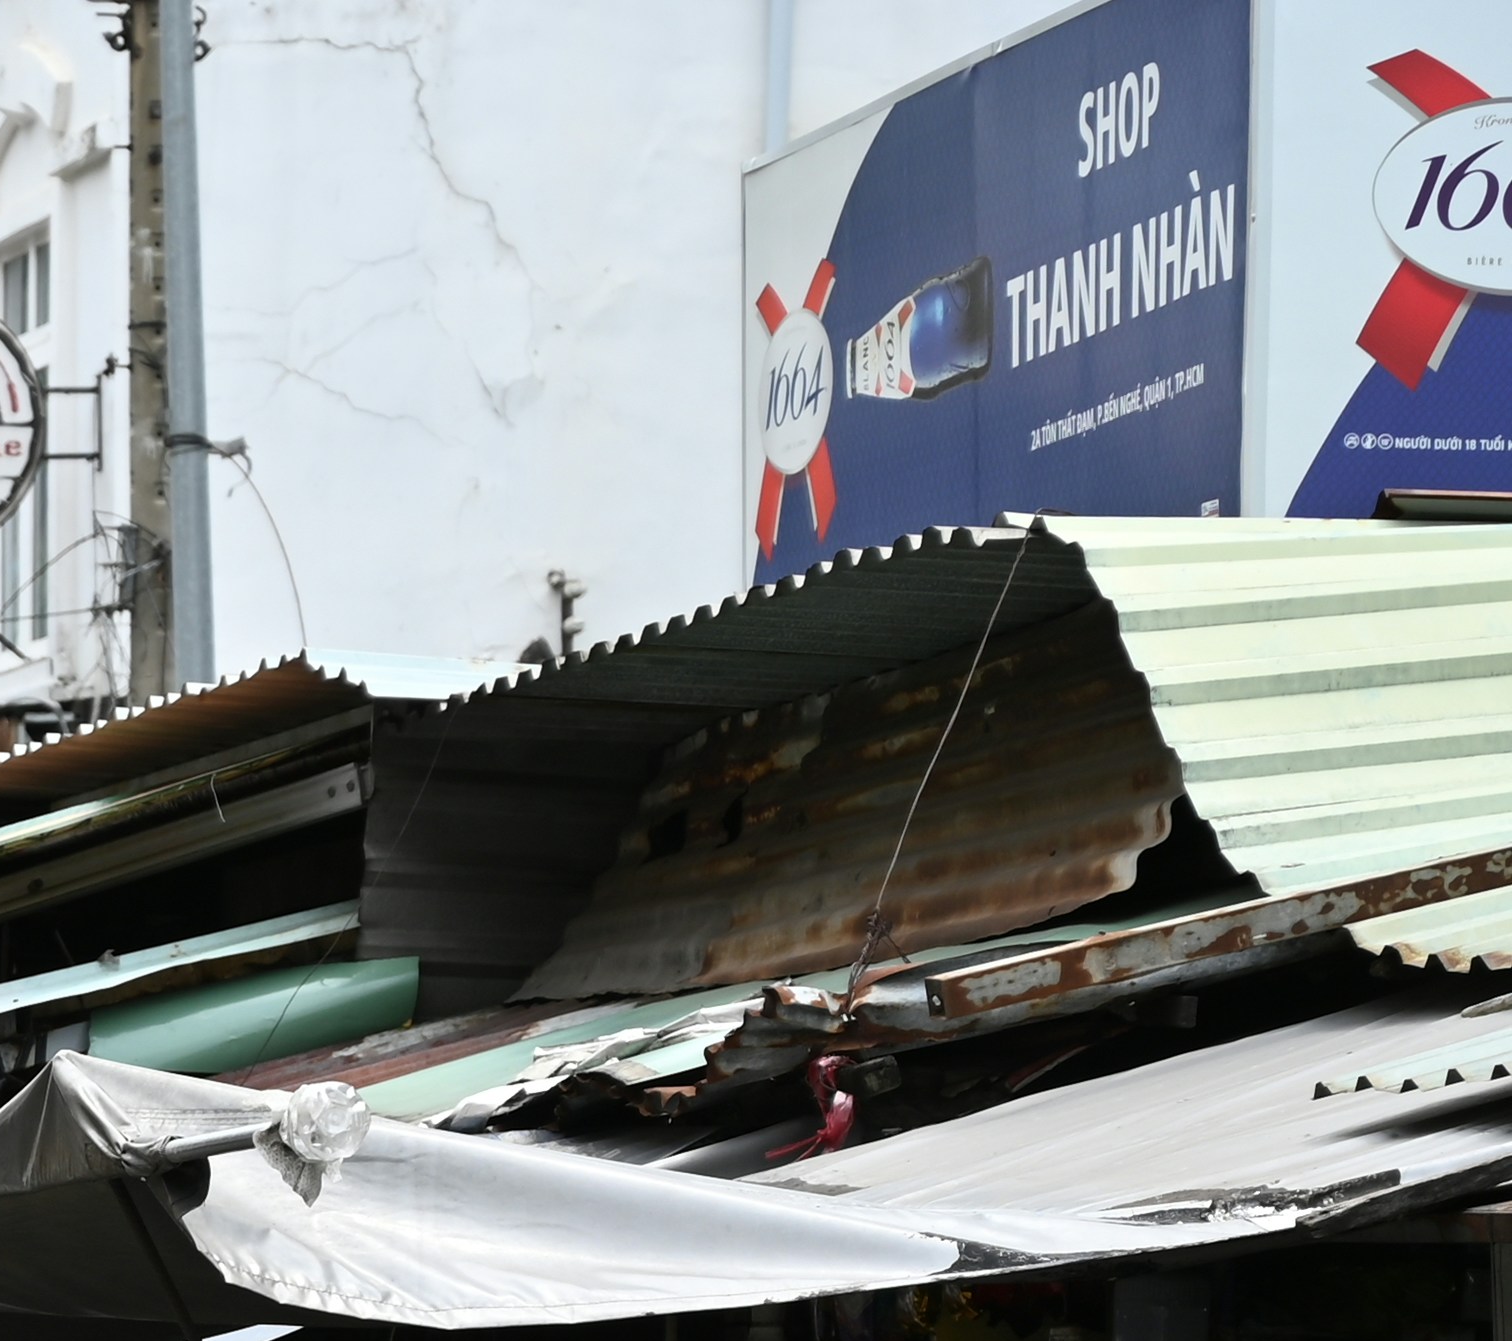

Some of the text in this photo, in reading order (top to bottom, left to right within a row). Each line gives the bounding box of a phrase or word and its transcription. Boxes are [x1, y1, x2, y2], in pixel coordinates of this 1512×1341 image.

[1077, 62, 1160, 180] SHOP
[1006, 170, 1236, 370] THANH NHÀN
[765, 341, 827, 433] 1664
[1030, 429, 1042, 451] 2A
[1041, 418, 1057, 445] TÔN
[1058, 408, 1077, 440] THẤT
[1143, 376, 1166, 410] QUẬN
[1174, 363, 1205, 395] TP.HCM
[1394, 433, 1505, 451] NGƯỜI DƯỚI 18 TUỔI
